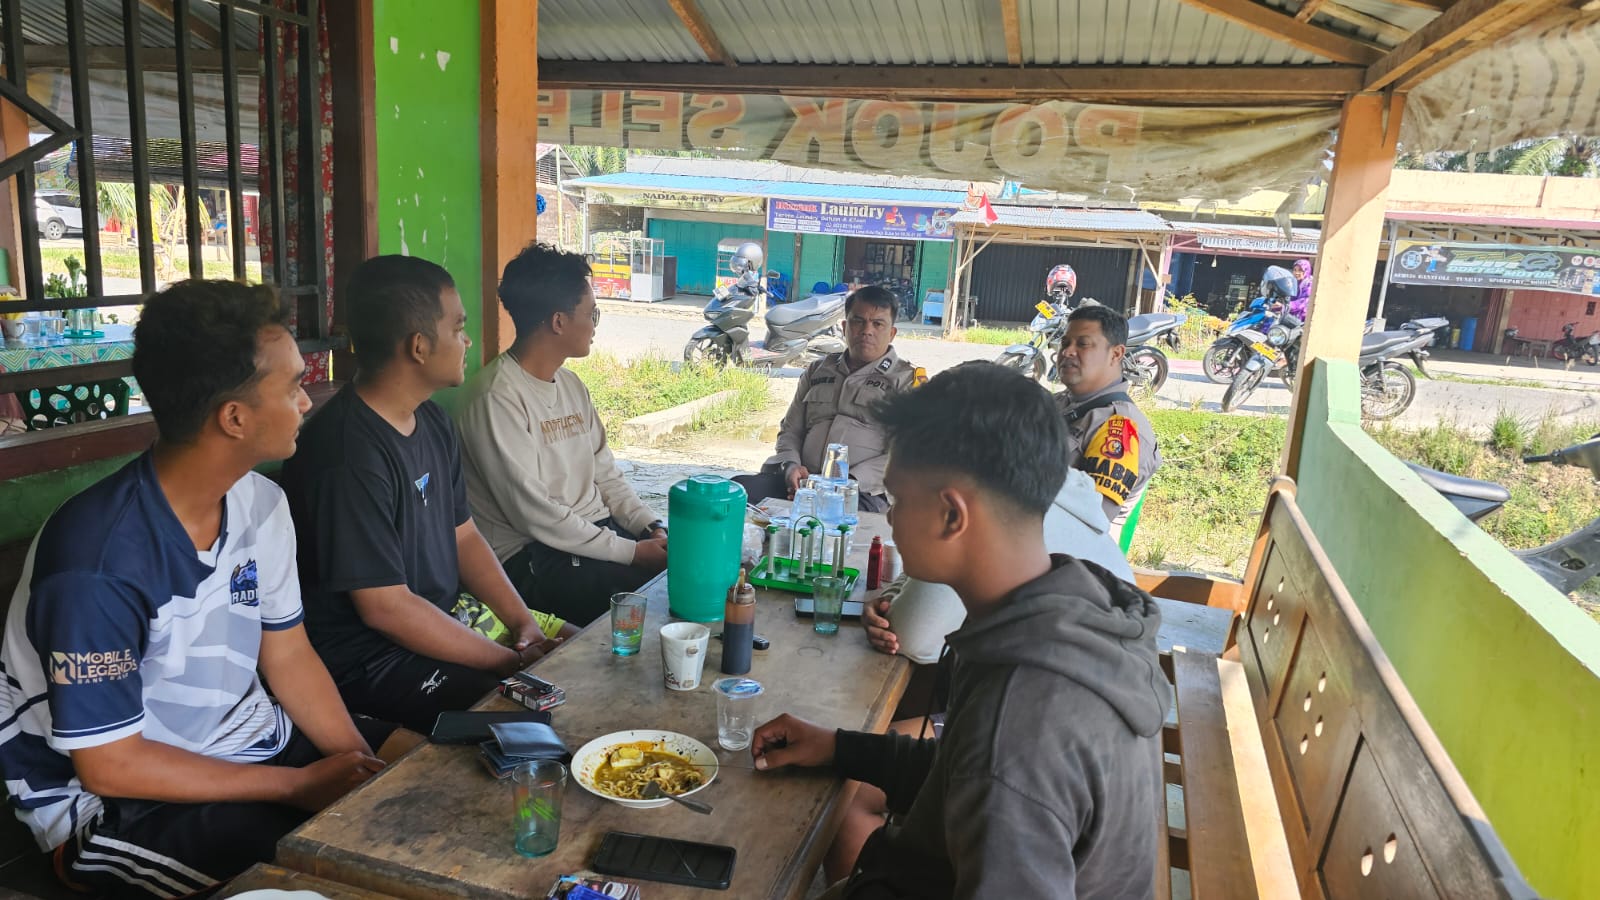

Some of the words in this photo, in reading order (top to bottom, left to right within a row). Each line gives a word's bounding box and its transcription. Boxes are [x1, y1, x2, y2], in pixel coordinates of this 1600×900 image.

[643, 192, 676, 201] NADIA
[820, 202, 885, 220] Laundry
[77, 648, 132, 665] MOBILE
[77, 659, 138, 679] LEGENDS
